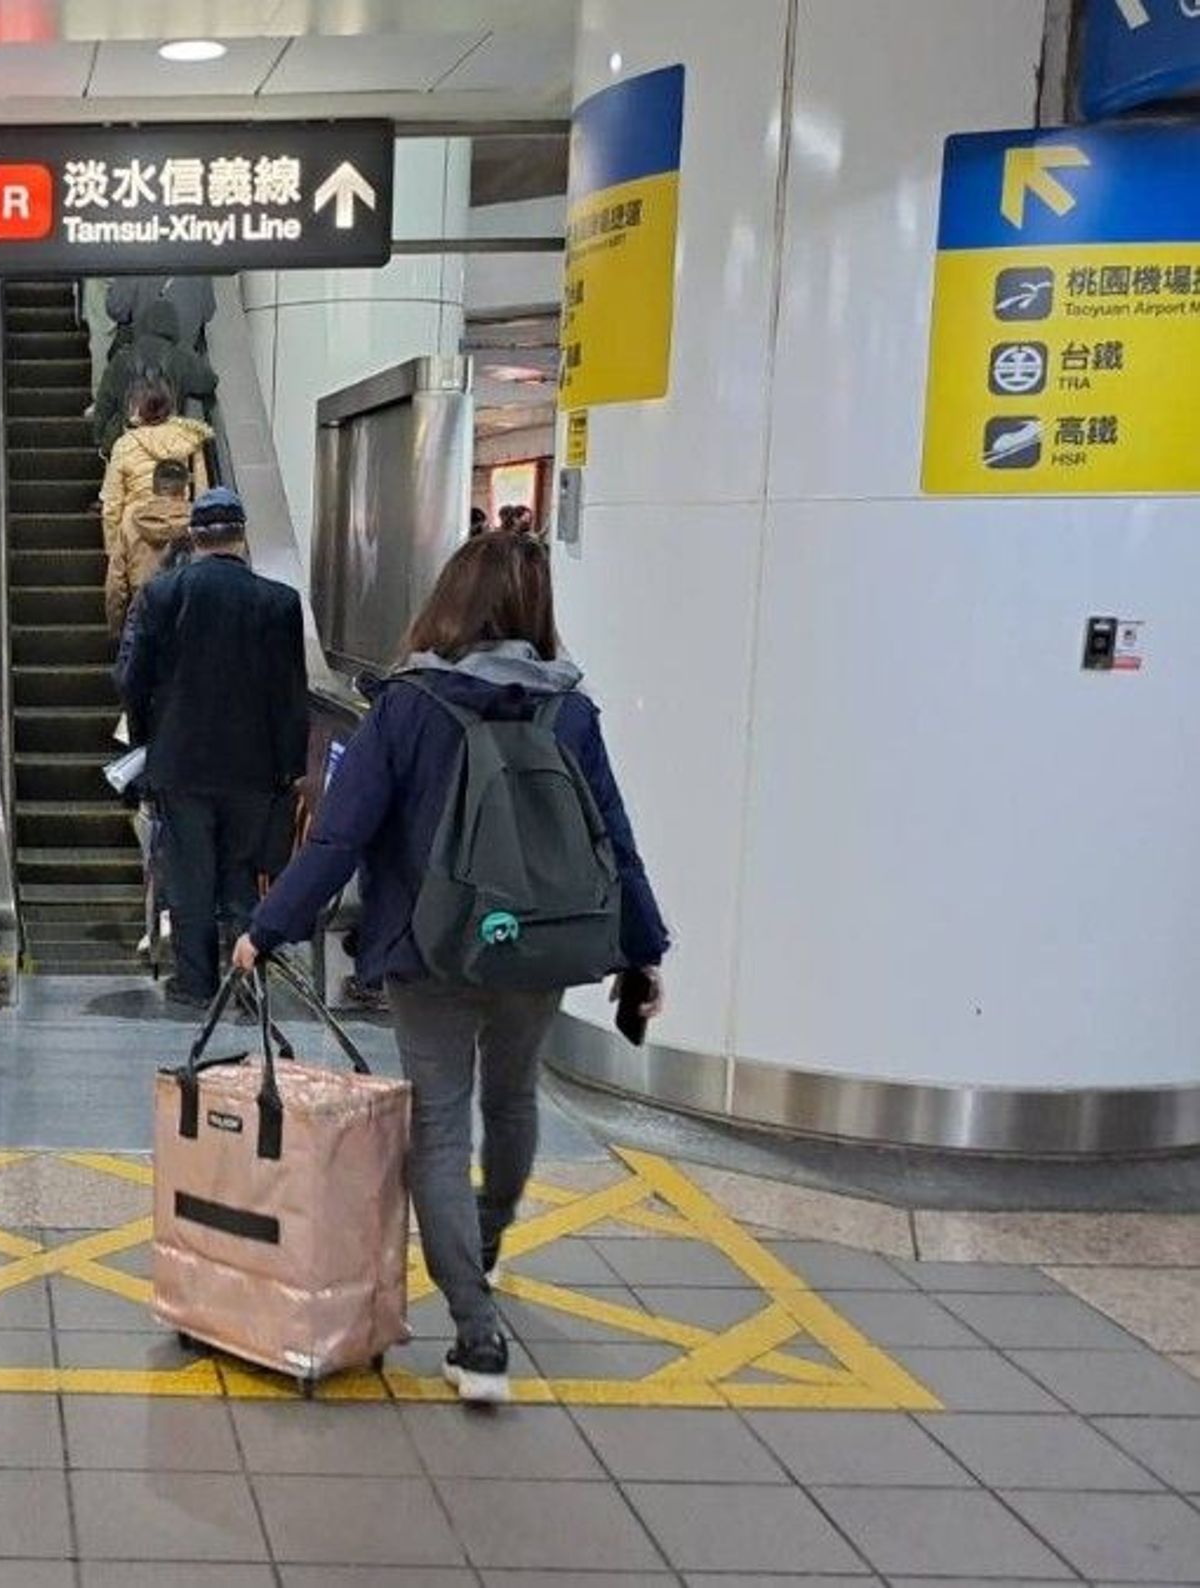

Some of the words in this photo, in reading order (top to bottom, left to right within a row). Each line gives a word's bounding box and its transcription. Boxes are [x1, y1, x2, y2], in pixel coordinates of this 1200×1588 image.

[63, 156, 301, 207] 淡水信義線
[2, 185, 30, 219] R
[62, 214, 235, 245] Tamsui-Xinyi
[242, 215, 300, 241] Line
[1064, 303, 1130, 317] Taoyuan
[1133, 302, 1186, 316] Airport
[1061, 341, 1123, 370] 台鐵
[1059, 377, 1091, 390] TRA
[1054, 415, 1118, 445] 高鐵
